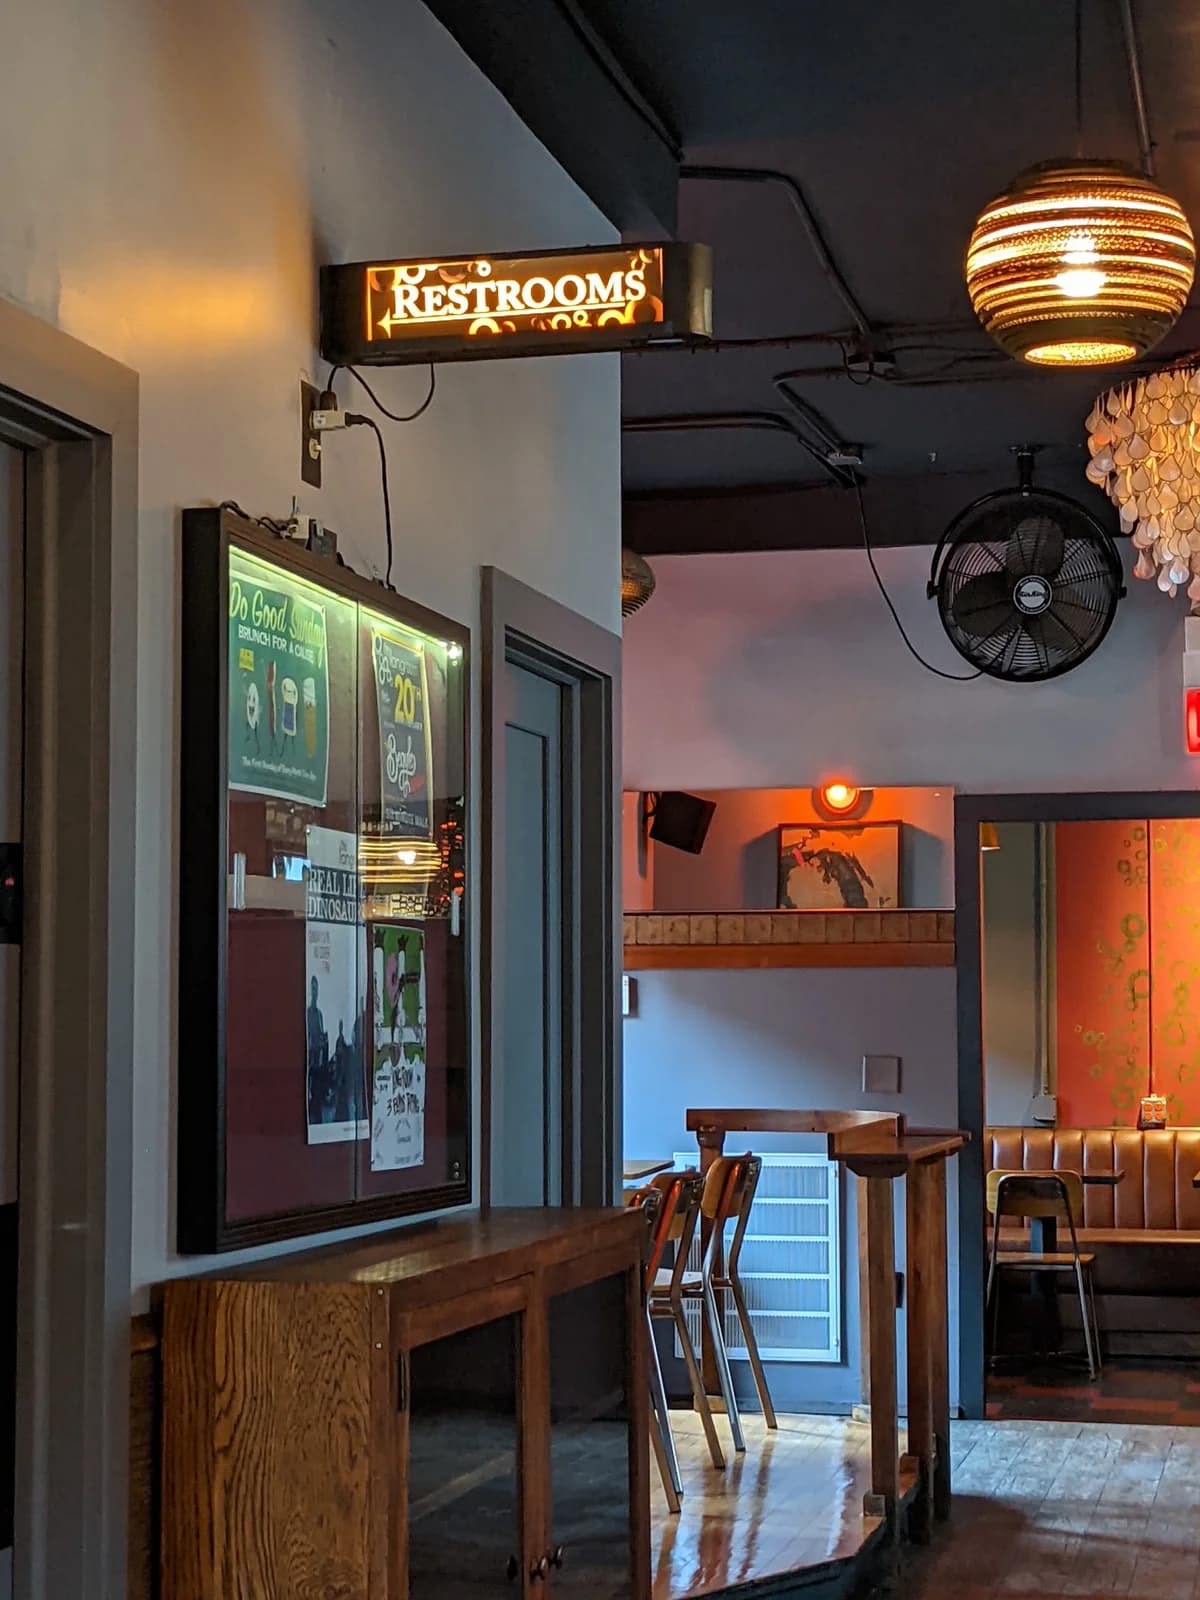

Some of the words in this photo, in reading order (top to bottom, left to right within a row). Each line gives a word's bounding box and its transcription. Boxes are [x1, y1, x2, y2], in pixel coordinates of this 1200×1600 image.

[391, 269, 647, 319] RESTROOMS
[230, 582, 248, 620] Do
[252, 590, 287, 632] Good
[238, 624, 270, 647] BRUNCH
[272, 635, 287, 651] FOR
[309, 869, 340, 895] REAL
[308, 895, 364, 922] DINOSAU
